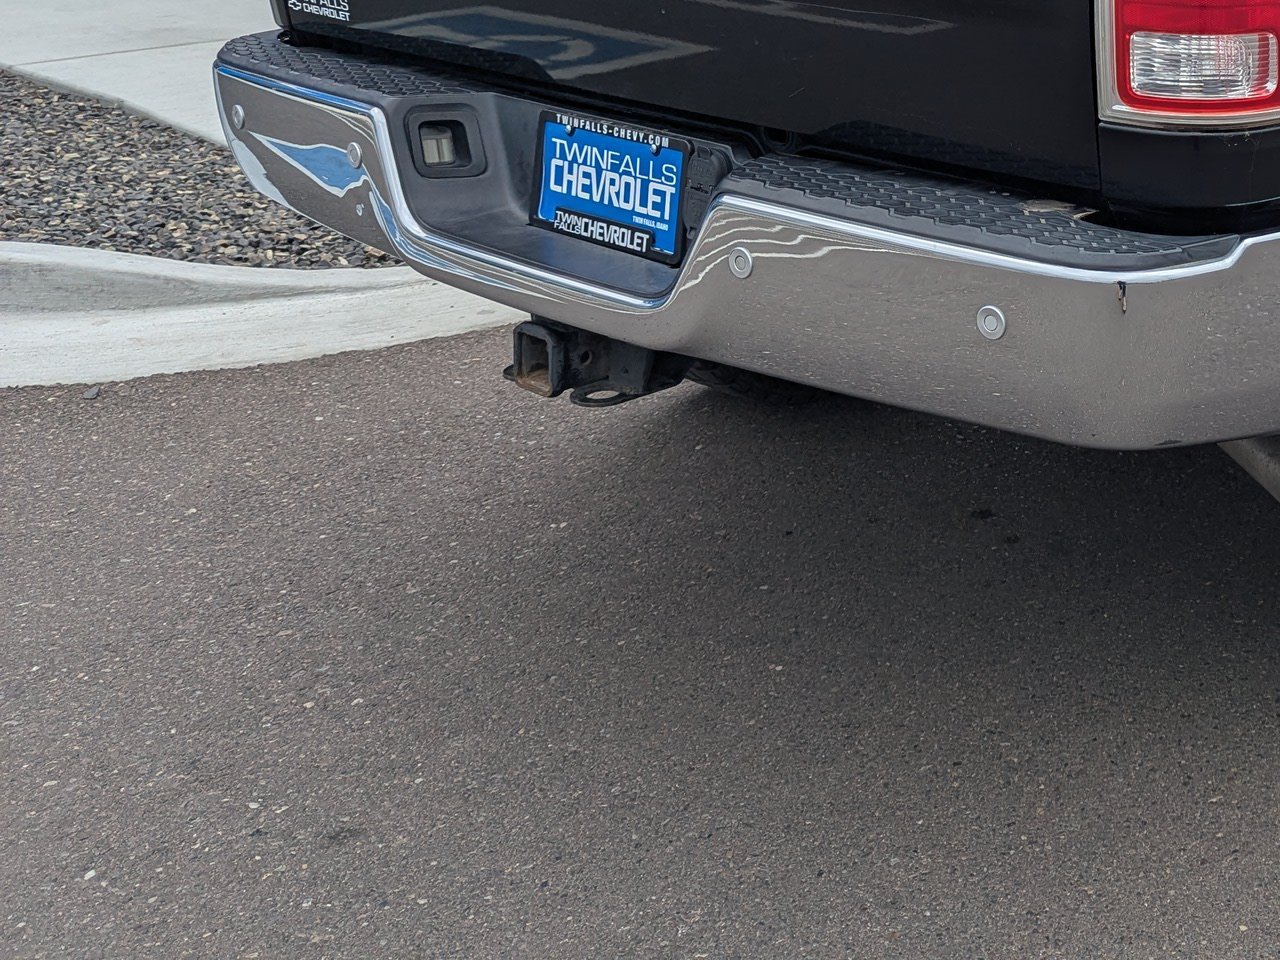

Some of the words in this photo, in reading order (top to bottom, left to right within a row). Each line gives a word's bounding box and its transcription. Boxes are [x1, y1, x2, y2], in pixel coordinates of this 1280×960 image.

[303, 3, 351, 21] CHEVROLET
[556, 113, 669, 148] TWINFALLS-CHEVY.COM
[551, 137, 677, 186] TWINFALLS
[549, 158, 676, 221] CHEVROLET
[554, 221, 581, 235] FALLS
[555, 210, 582, 226] TWIN
[580, 217, 650, 253] CHEVROLET
